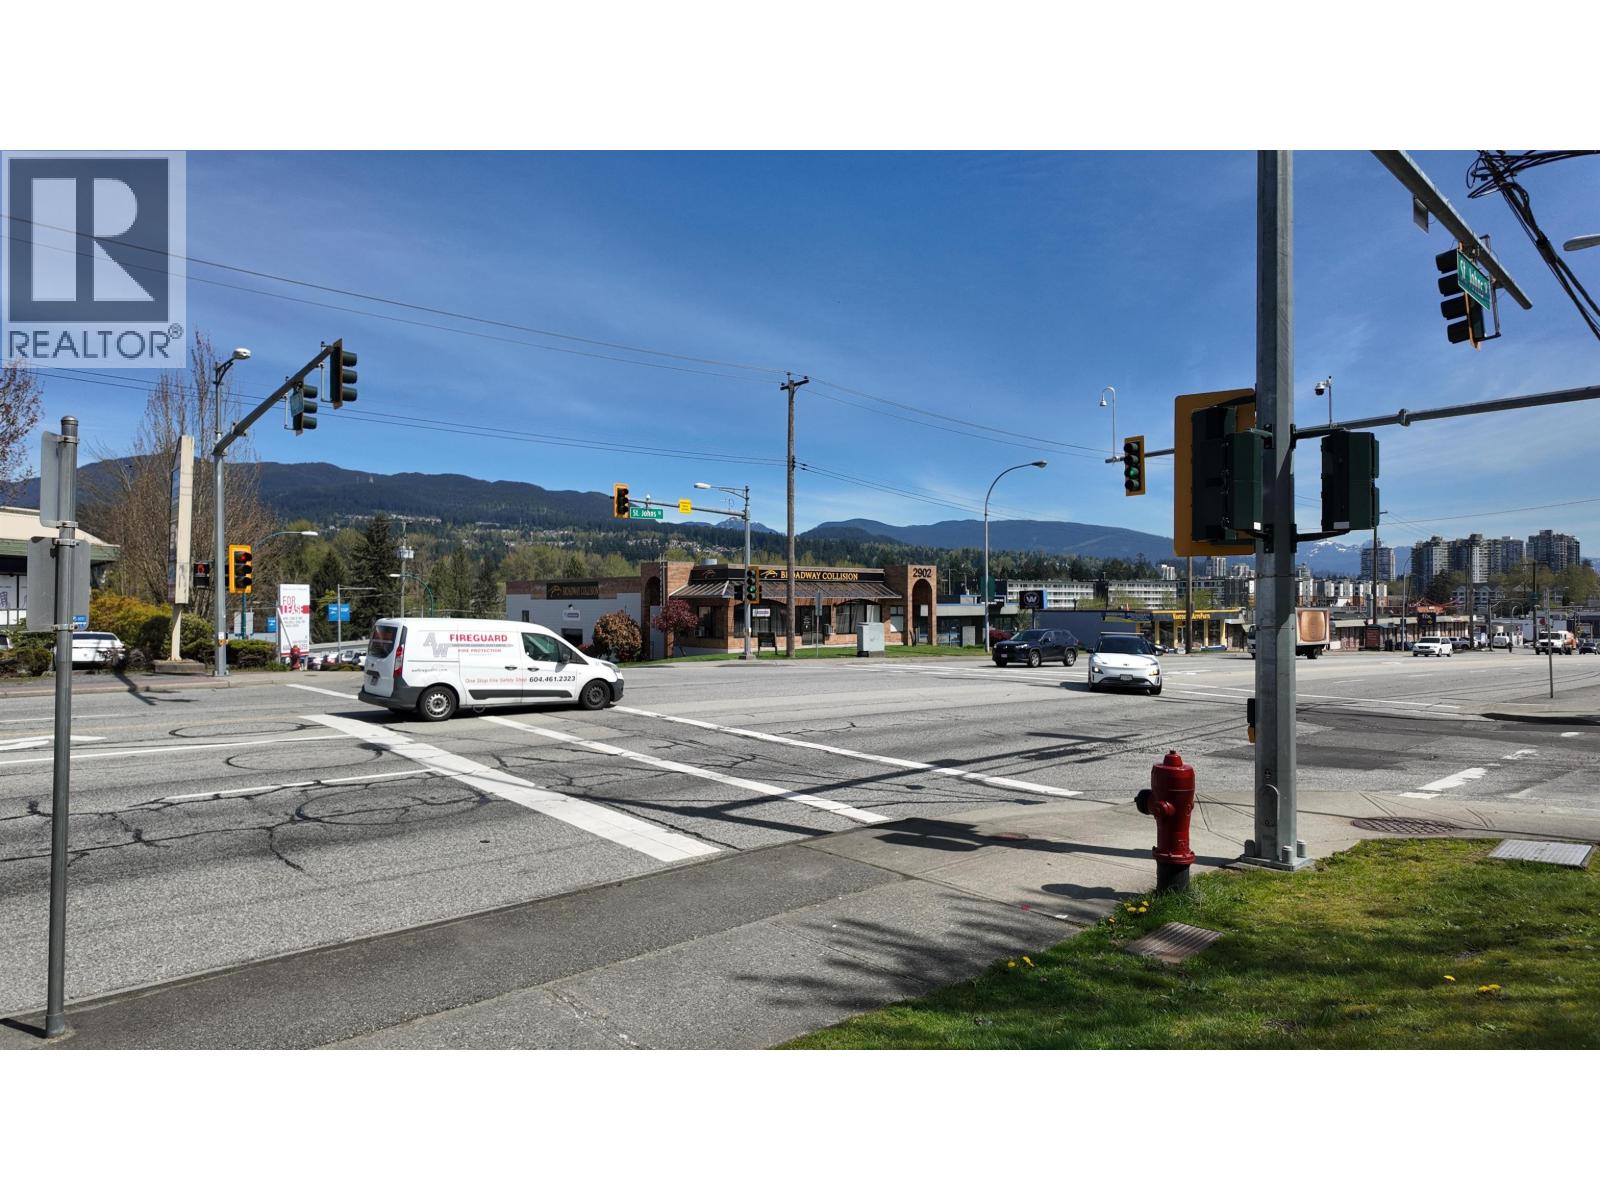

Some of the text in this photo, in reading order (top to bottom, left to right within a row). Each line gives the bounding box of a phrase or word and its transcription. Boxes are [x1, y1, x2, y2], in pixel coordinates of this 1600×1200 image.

[641, 510, 657, 518] Johns
[780, 571, 858, 581] BADWAY COLLISION
[912, 567, 932, 578] 2902
[282, 595, 296, 606] FOR
[282, 605, 304, 615] LEASE
[449, 633, 508, 642] FIREGUARD
[529, 675, 576, 683] 604.461.2323
